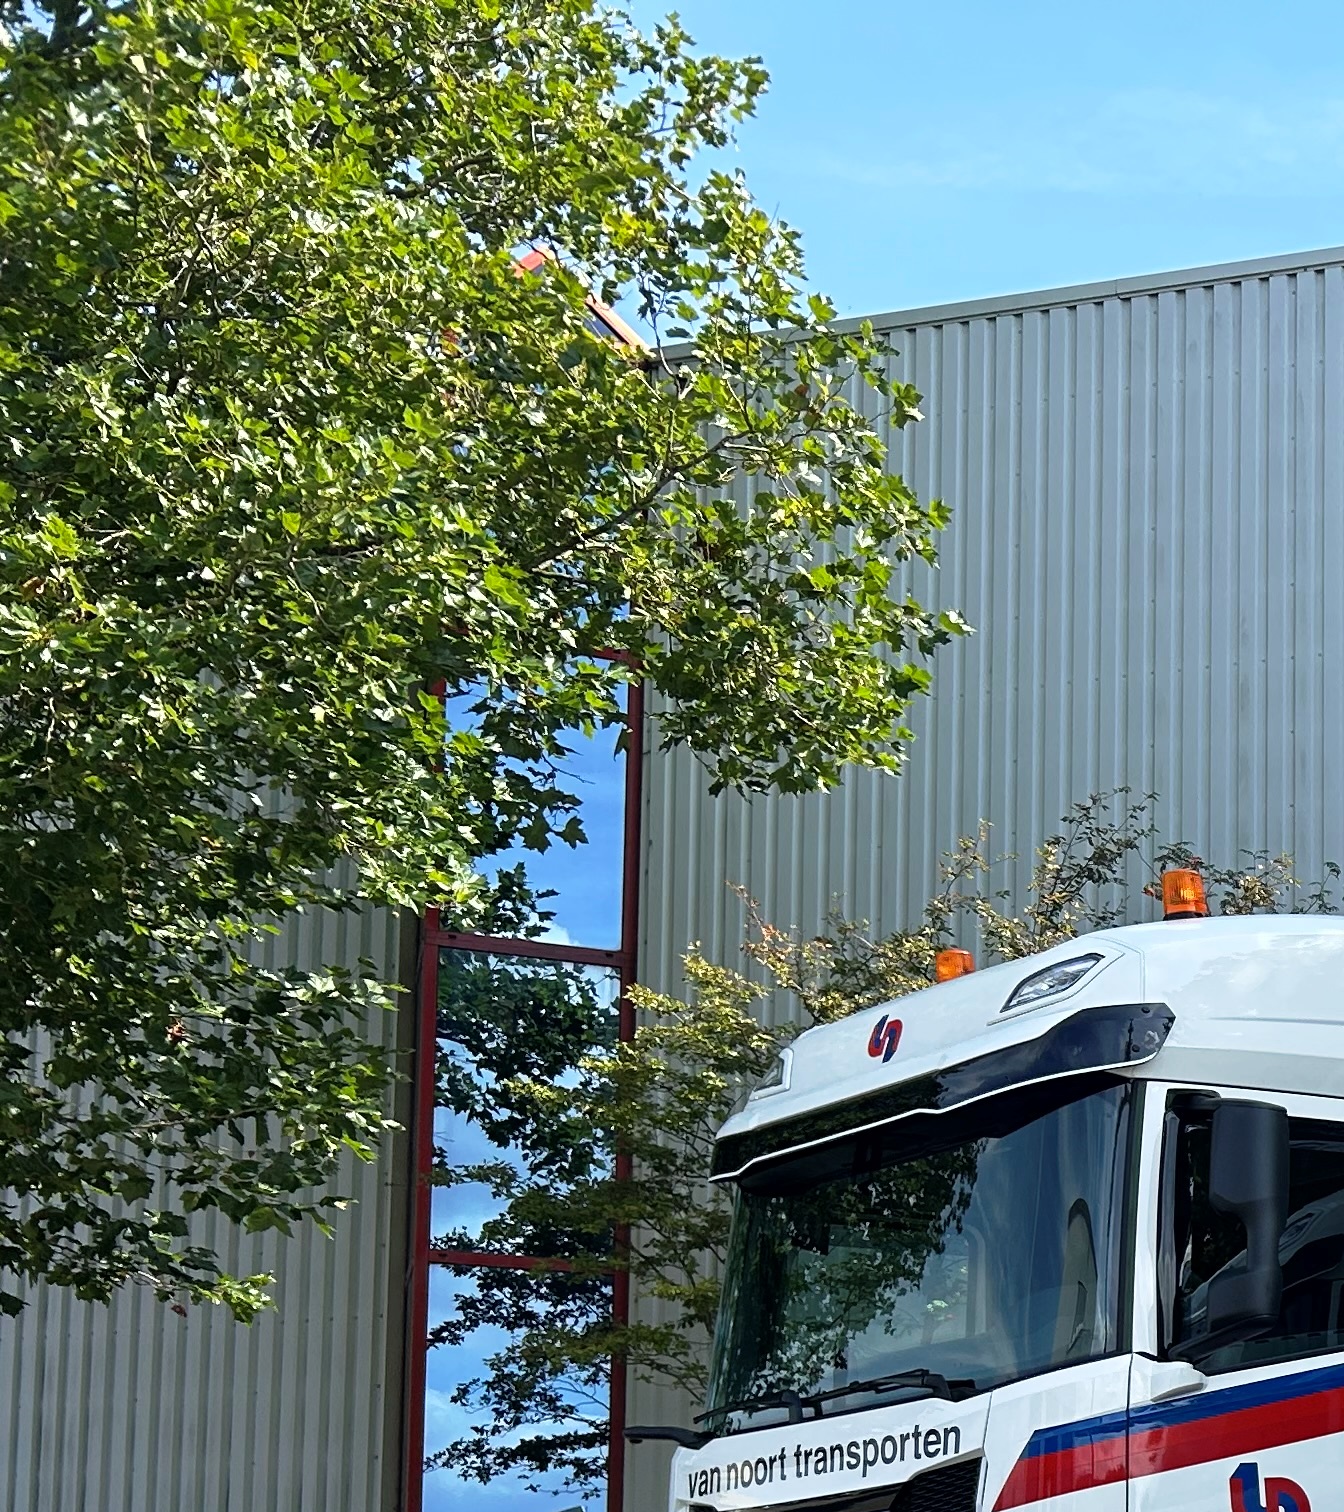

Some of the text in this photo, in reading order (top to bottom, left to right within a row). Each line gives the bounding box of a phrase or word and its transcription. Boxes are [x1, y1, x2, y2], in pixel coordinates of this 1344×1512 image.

[688, 1425, 961, 1499] van noort transporten
